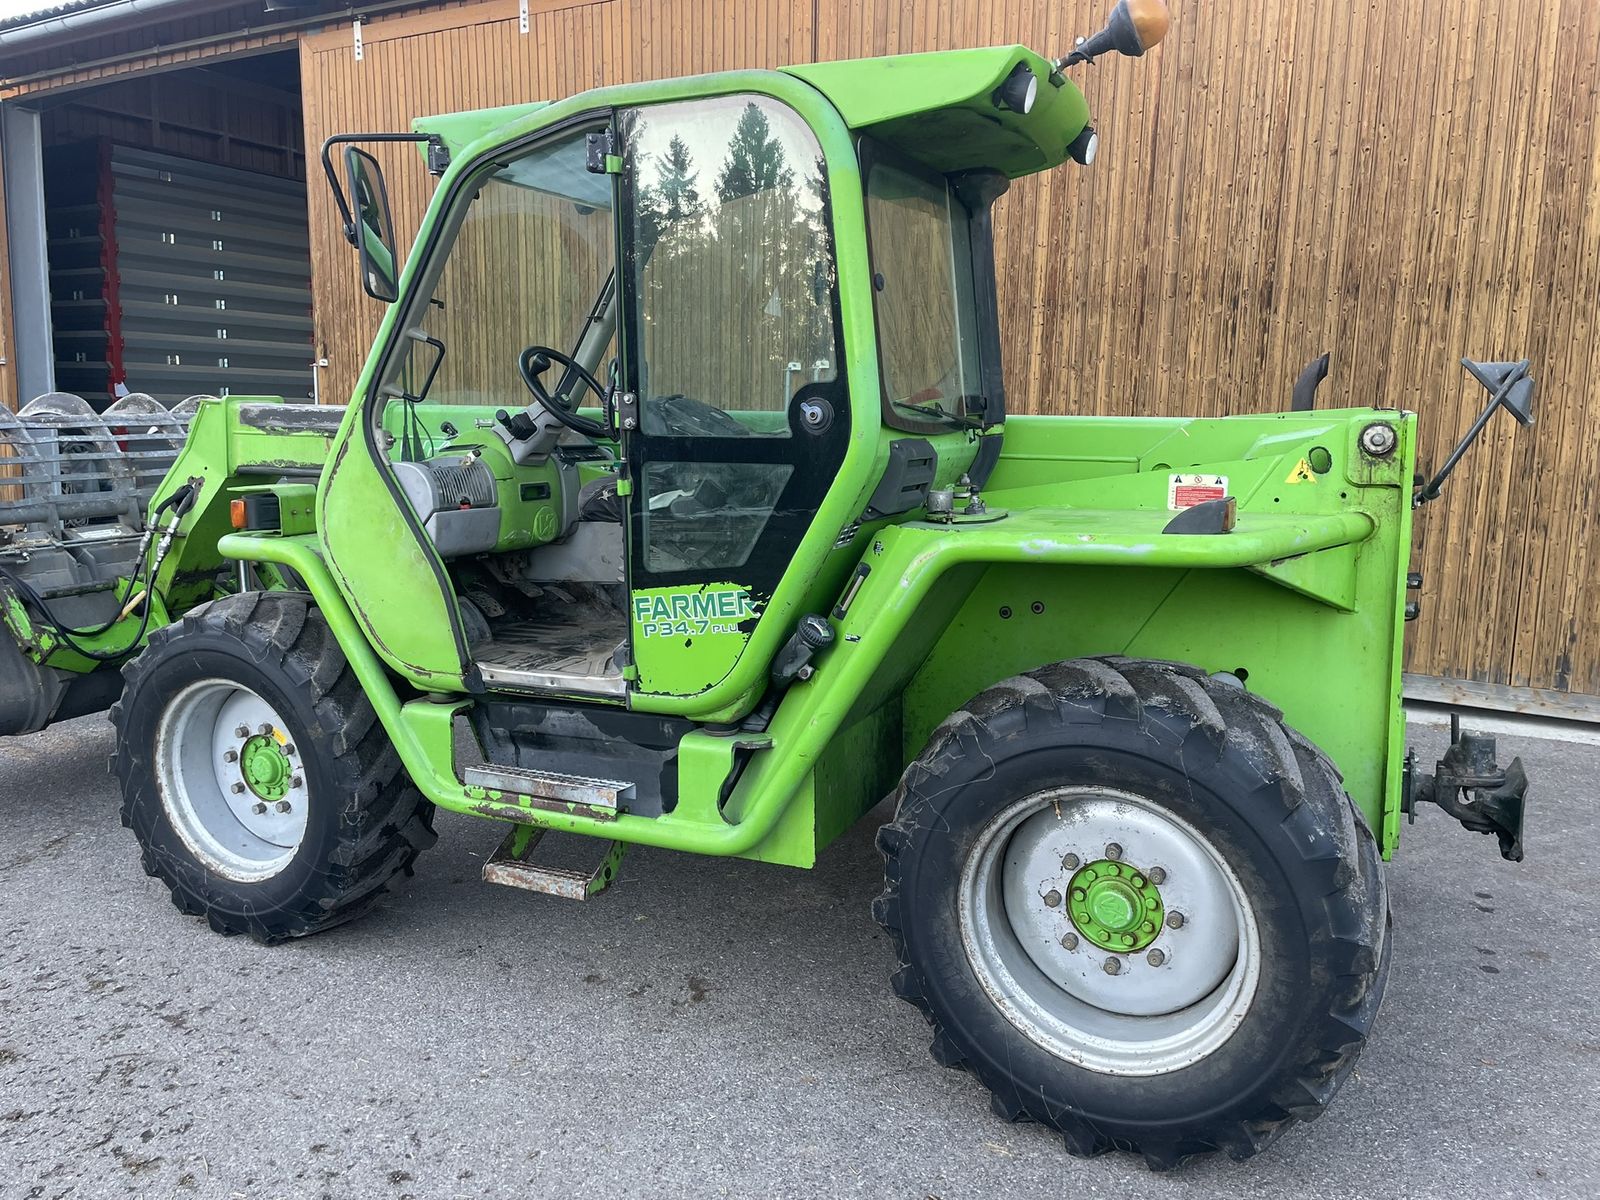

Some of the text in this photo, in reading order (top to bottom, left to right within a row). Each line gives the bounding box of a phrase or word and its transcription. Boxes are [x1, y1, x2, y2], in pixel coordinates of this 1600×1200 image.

[634, 591, 760, 621] FARMER
[643, 620, 743, 638] P34.7 PLU
